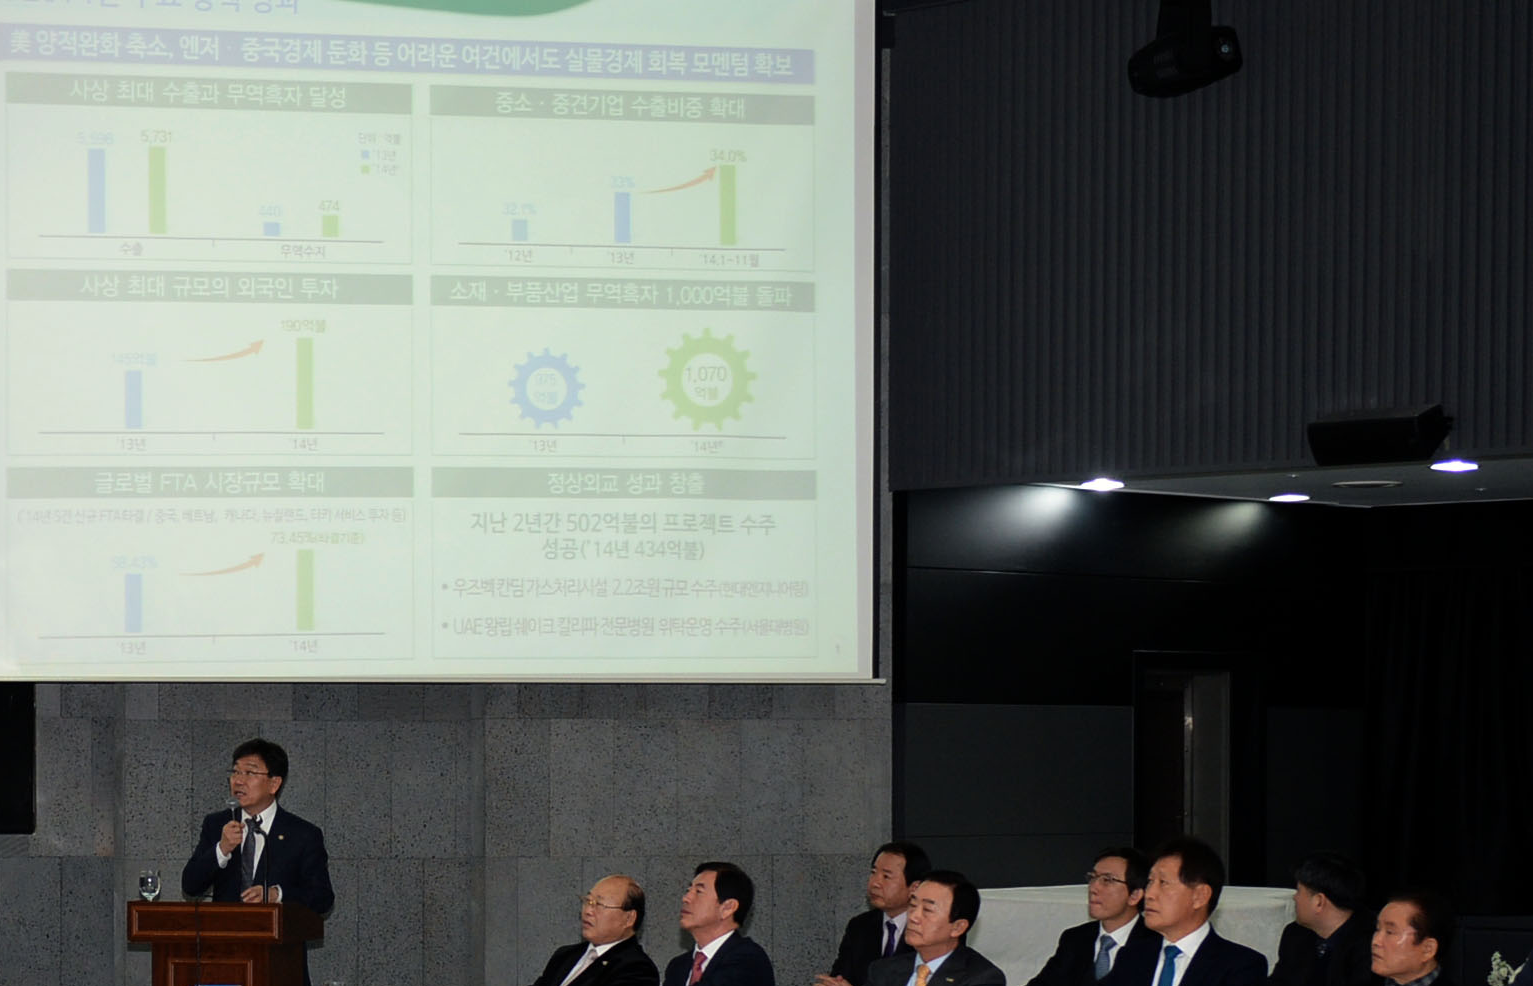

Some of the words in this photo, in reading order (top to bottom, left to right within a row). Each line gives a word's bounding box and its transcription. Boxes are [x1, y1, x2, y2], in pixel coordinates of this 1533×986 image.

[36, 30, 121, 57] 양적완화
[126, 33, 173, 59] 축소,
[179, 35, 219, 60] 엔저
[241, 37, 322, 64] 중국경제
[327, 40, 366, 66] 둔화
[372, 42, 392, 66] 등
[398, 42, 458, 68] 어려운
[461, 44, 561, 71] 여건에서도
[566, 48, 643, 74] 실물경제
[648, 50, 687, 75] 회복
[691, 51, 749, 77] 모멘텀
[754, 53, 794, 77] 확보
[70, 80, 109, 103] 사상
[117, 81, 155, 103] 최대
[162, 82, 219, 105] 수출과
[227, 84, 302, 107] 무역흑자
[309, 86, 347, 109] 달성
[496, 92, 532, 114] 중소
[552, 94, 624, 116] 중견기업
[631, 95, 704, 118] 수출비중
[709, 97, 746, 120] 확대
[140, 129, 173, 144] 5,731
[318, 200, 340, 213] 474
[80, 276, 120, 297] 사상
[128, 276, 165, 298] 최대
[173, 278, 229, 298] 규모의
[238, 278, 294, 300] 외국인
[301, 279, 339, 300] 투자
[450, 281, 487, 301] 소재
[506, 282, 579, 303] 부품산업
[586, 283, 658, 305] 무역흑자
[667, 284, 749, 307] 1,000억불
[756, 286, 792, 307] 돌파
[684, 365, 727, 383] 1,070
[94, 472, 154, 493] 글로벌
[159, 473, 197, 493] FTA
[206, 472, 281, 493] 시장규모
[288, 471, 325, 493] 확대
[547, 472, 619, 494] 정상외교
[626, 473, 663, 494] 성과
[670, 473, 706, 495] 창출
[470, 512, 507, 534] 지난
[513, 512, 562, 534] 2년간
[567, 512, 657, 535] 502억불의
[663, 512, 735, 536] 프로젝트
[740, 514, 776, 537] 수주
[634, 539, 706, 561] 434억불)
